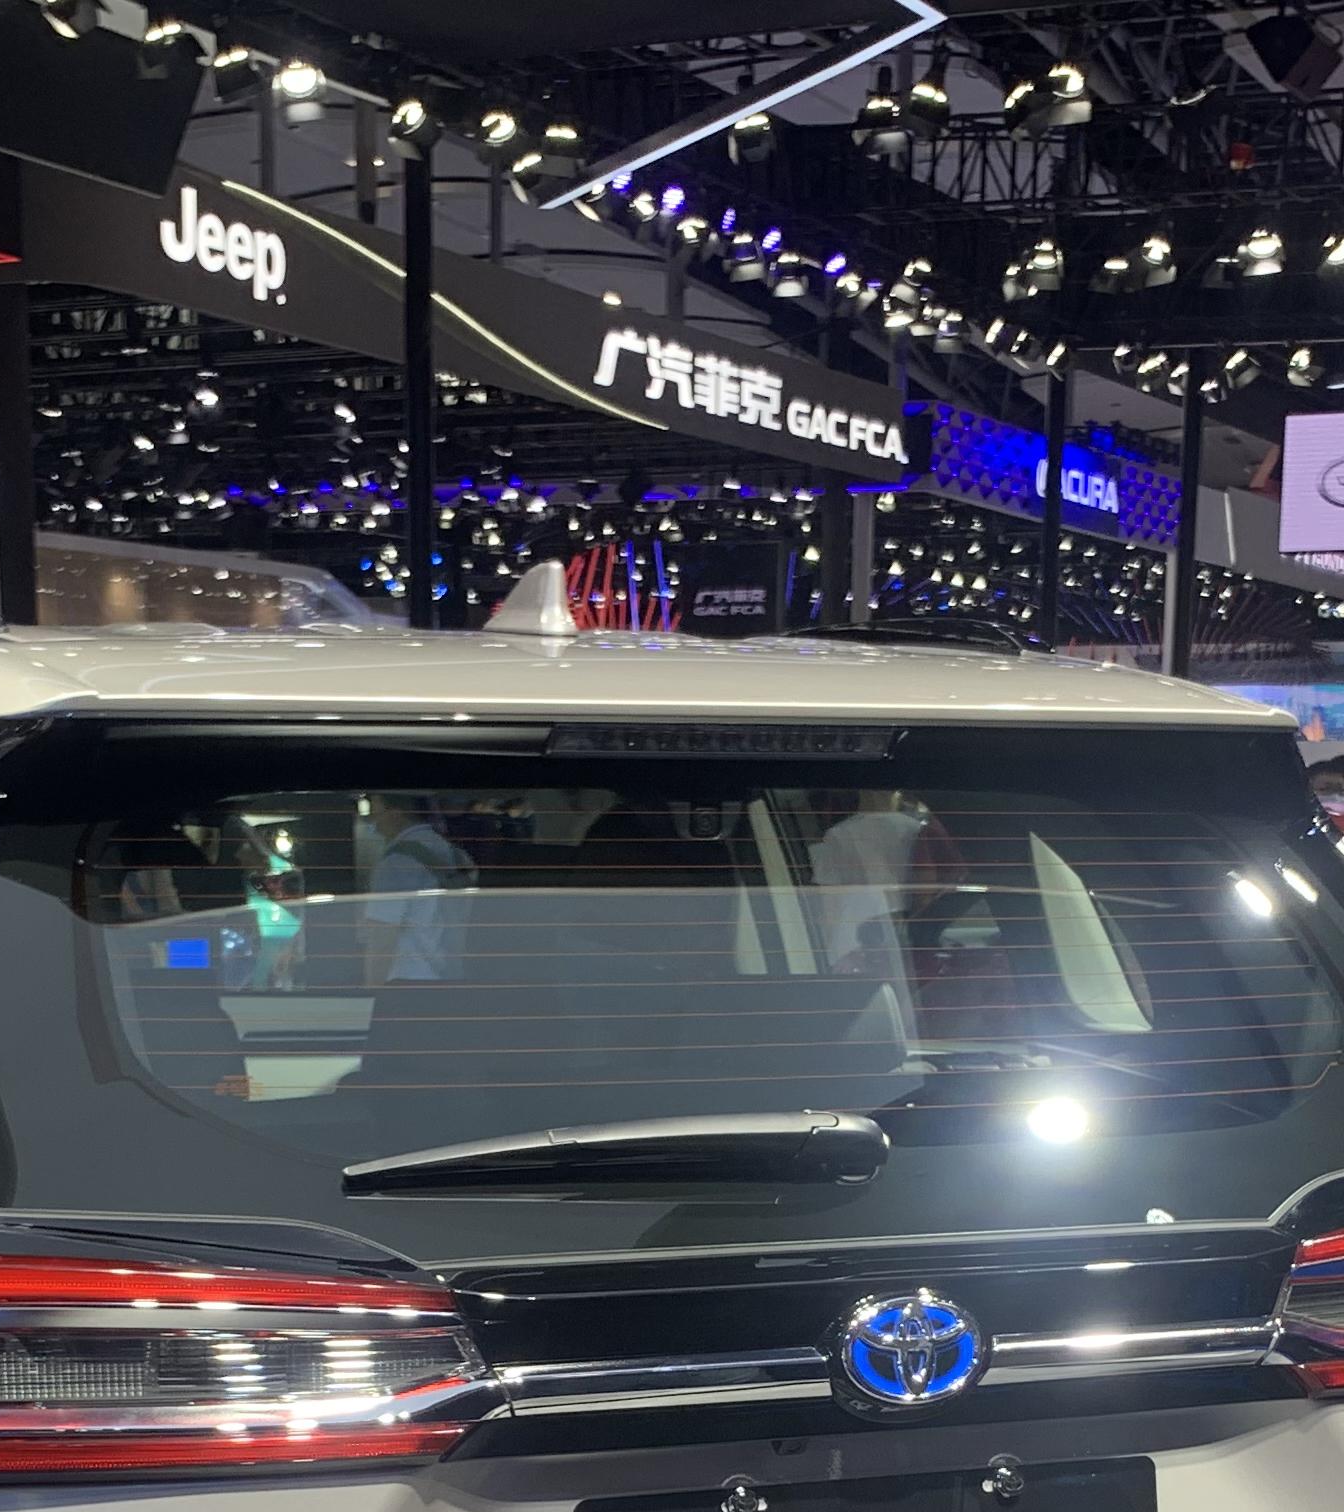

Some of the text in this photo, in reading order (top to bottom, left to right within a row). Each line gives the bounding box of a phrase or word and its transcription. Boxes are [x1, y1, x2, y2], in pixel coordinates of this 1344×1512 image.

[159, 186, 287, 303] Jeep
[593, 328, 905, 461] 广汽菲克 GAC FCA
[1060, 468, 1119, 514] CURA
